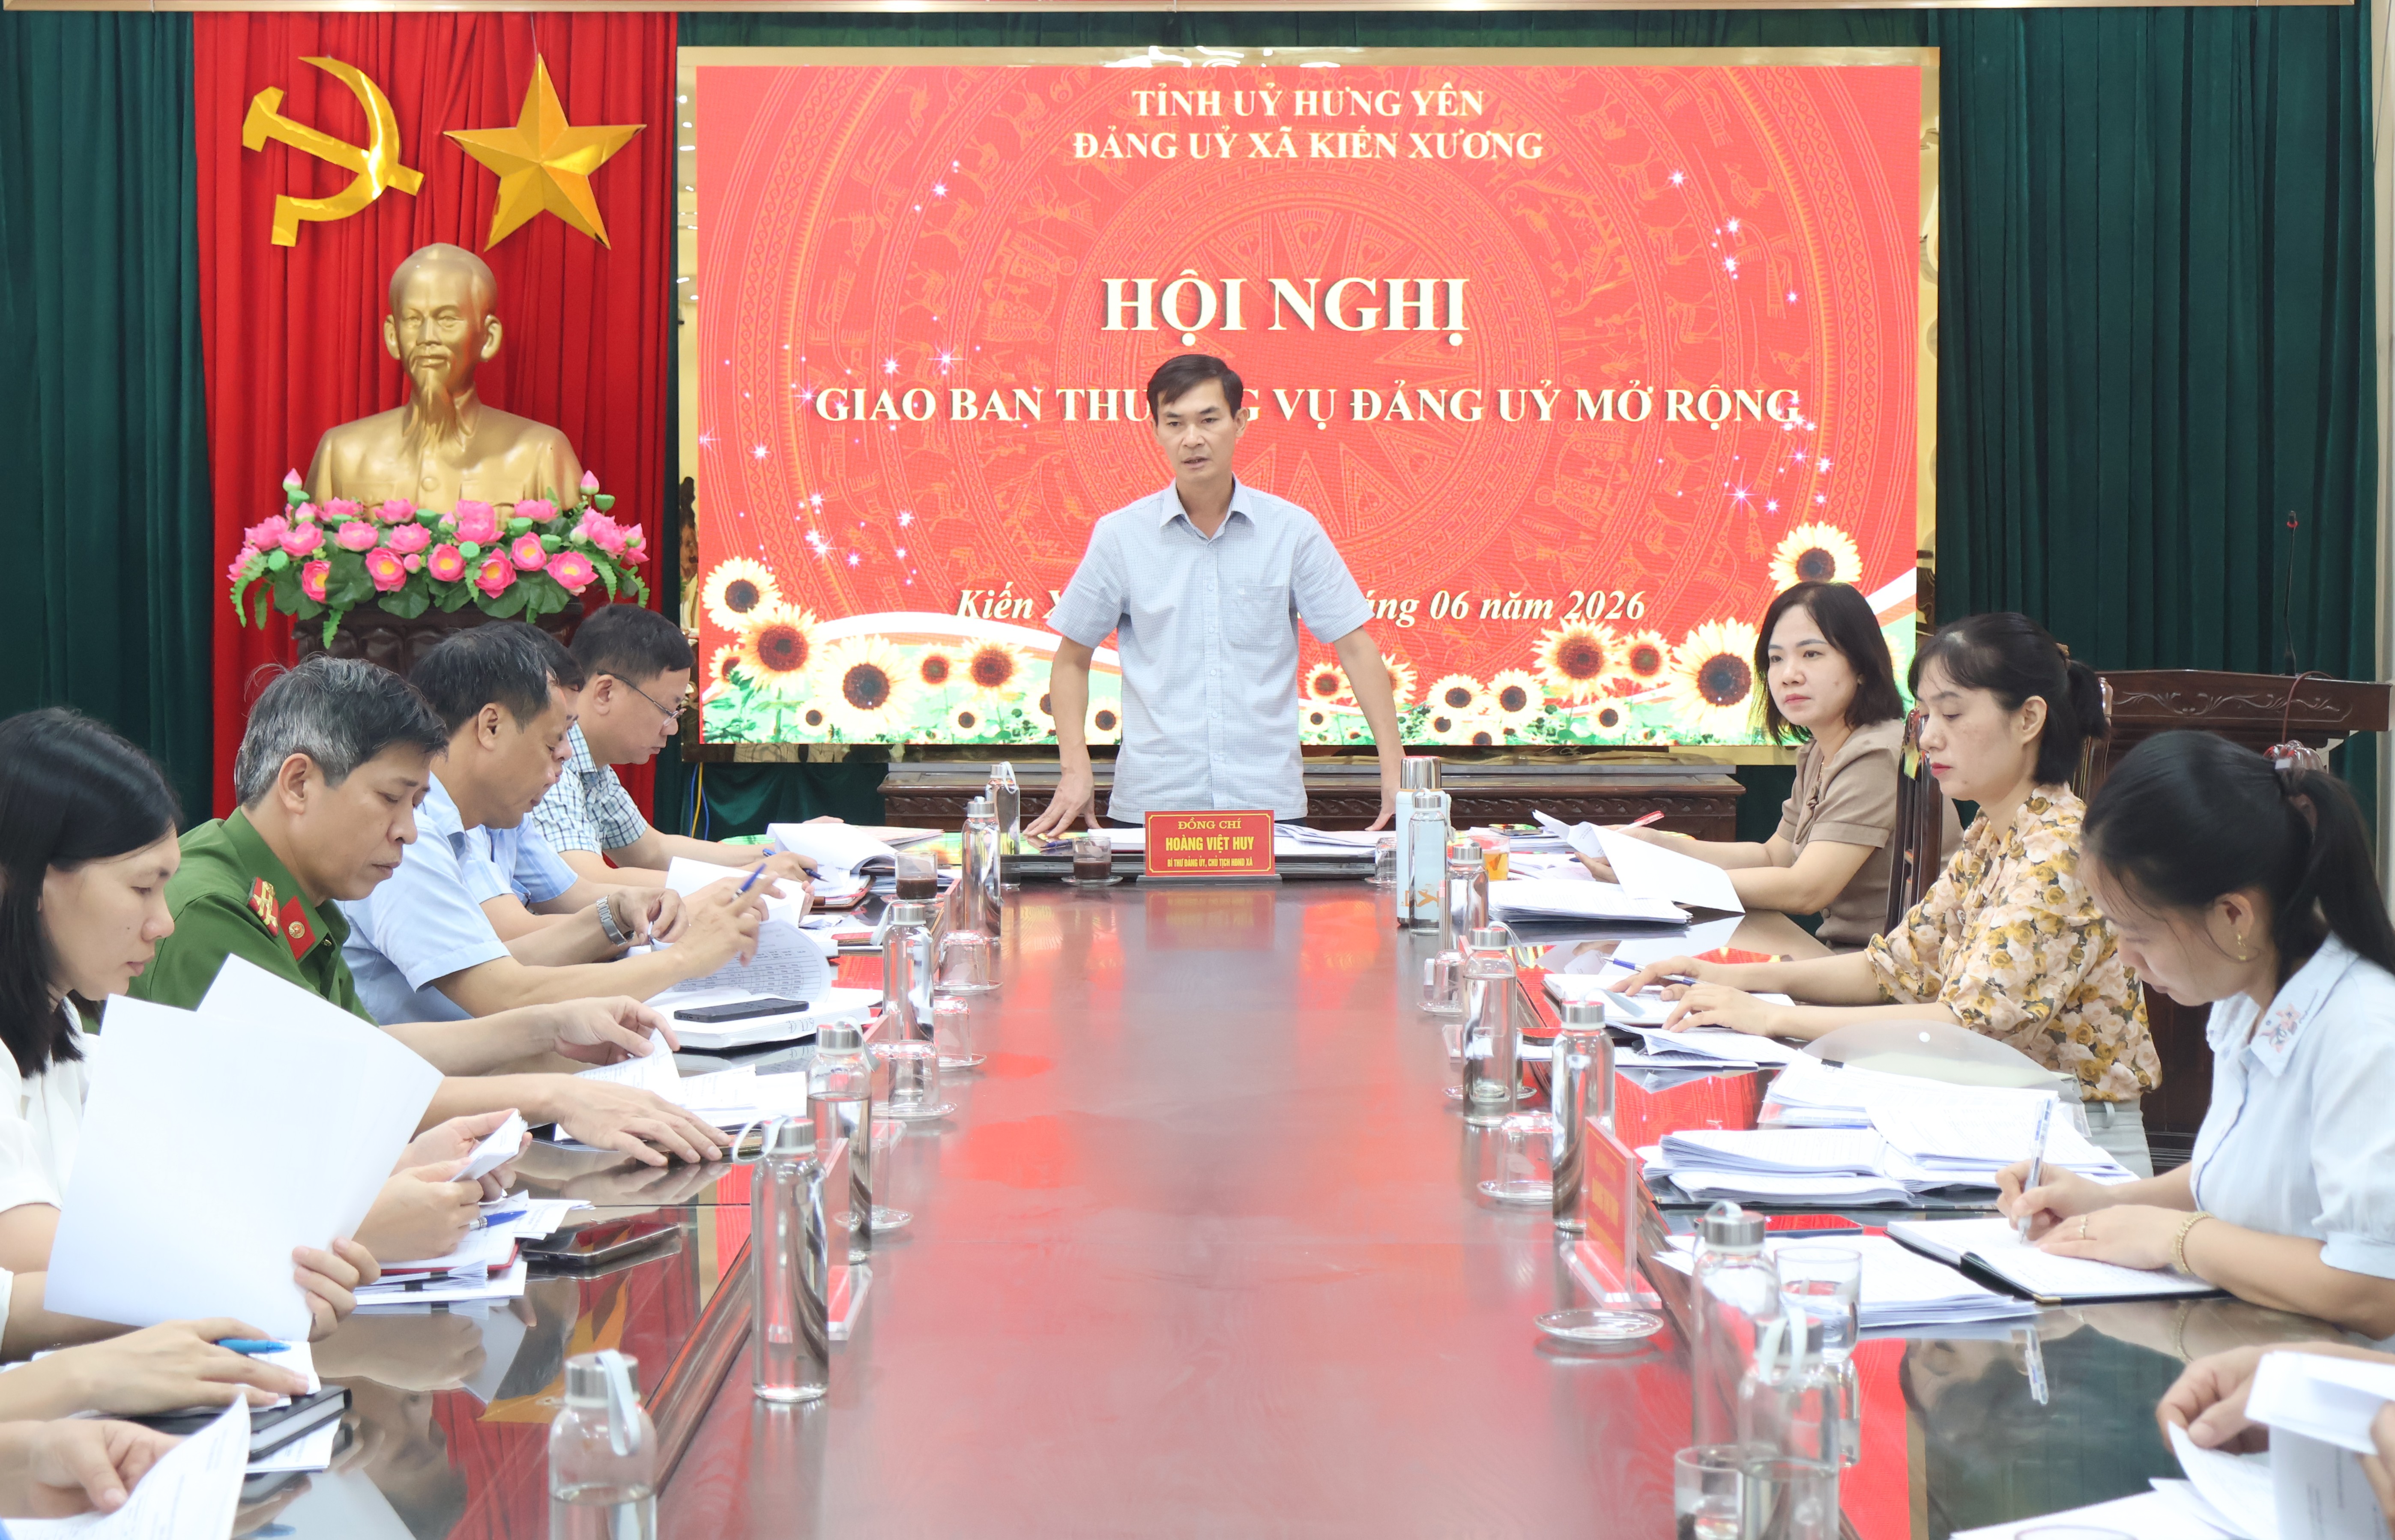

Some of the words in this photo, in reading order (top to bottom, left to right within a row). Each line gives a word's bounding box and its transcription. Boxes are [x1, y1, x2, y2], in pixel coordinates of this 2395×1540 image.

[1132, 83, 1222, 116] TỈNH
[1234, 82, 1283, 116] UỶ
[1294, 86, 1402, 116] HƯNG
[1411, 81, 1483, 116] YÊN
[1073, 125, 1178, 159] ĐẢNG
[1189, 125, 1238, 159] UỶ
[1248, 126, 1298, 158] XÃ
[1309, 125, 1398, 159] KIẾN
[1408, 128, 1543, 159] XƯƠNG
[1101, 269, 1247, 347] HỘI
[1268, 277, 1471, 347] NGHỊ
[816, 388, 936, 422] GIAO
[950, 388, 1044, 422] BAN
[1273, 389, 1338, 430] VỤ
[1350, 380, 1484, 422] ĐẢNG
[1498, 380, 1561, 422] UỶ
[1575, 380, 1653, 422] MỞ
[1665, 384, 1800, 431] RỘNG
[955, 581, 1034, 619] Kiến
[1430, 590, 1470, 619] 06
[1480, 591, 1554, 619] năm
[1564, 590, 1646, 620] 2026
[1178, 817, 1216, 830] ĐỒNG
[1219, 818, 1242, 829] CHÍ
[1165, 834, 1203, 851] HOÀNG
[1206, 834, 1230, 853] VIỆT
[1232, 836, 1255, 850] HUY
[1219, 858, 1231, 868] TỊCH
